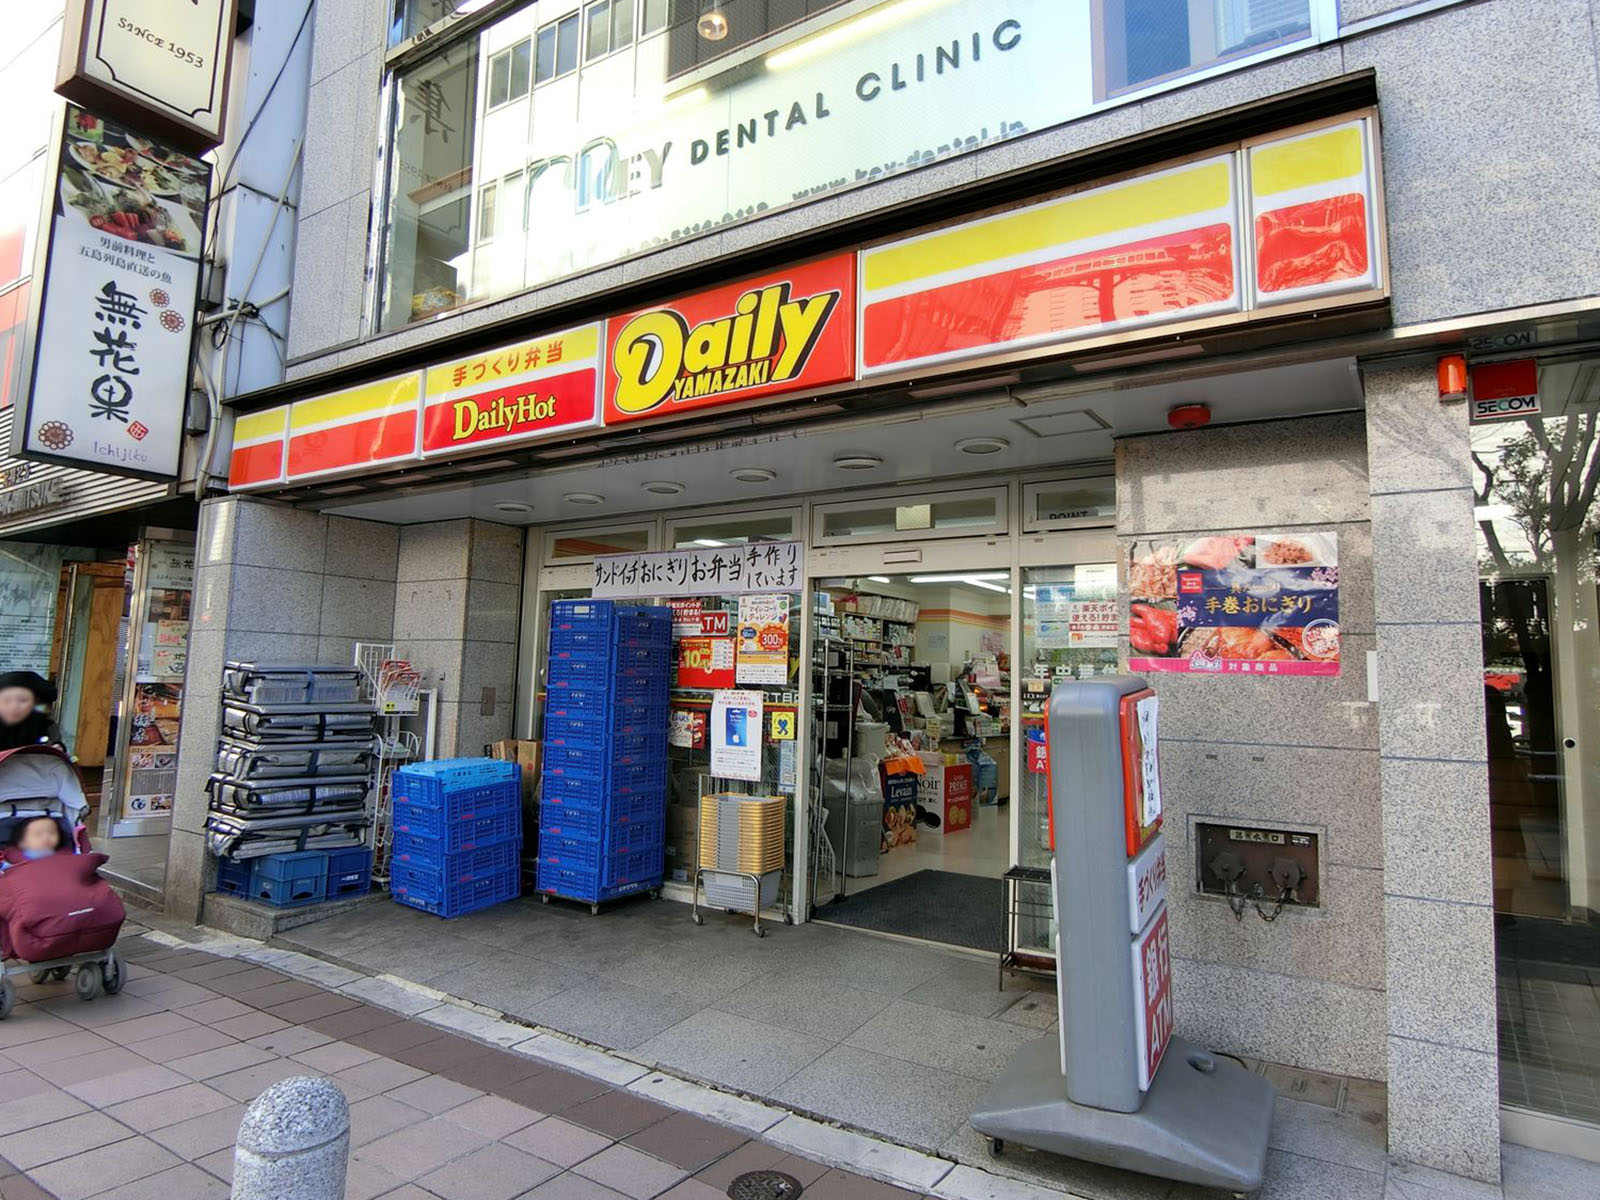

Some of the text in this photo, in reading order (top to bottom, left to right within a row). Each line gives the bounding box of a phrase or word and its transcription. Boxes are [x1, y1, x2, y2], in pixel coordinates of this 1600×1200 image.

[167, 42, 205, 68] 1953
[690, 92, 830, 166] DENTAL
[855, 19, 1022, 102] CLINIC
[88, 280, 149, 423] 無花果
[452, 339, 563, 388] 手づくり弁当
[612, 282, 841, 413] Daily
[674, 359, 770, 401] YAMAZAKI
[453, 393, 557, 441] DailyHot
[1477, 396, 1537, 414] SECOM
[640, 557, 688, 586] おにぎり
[691, 553, 742, 584] お弁当
[746, 545, 797, 568] 手作り
[746, 566, 798, 589] しています
[1204, 595, 1312, 615] 手巻おにぎり
